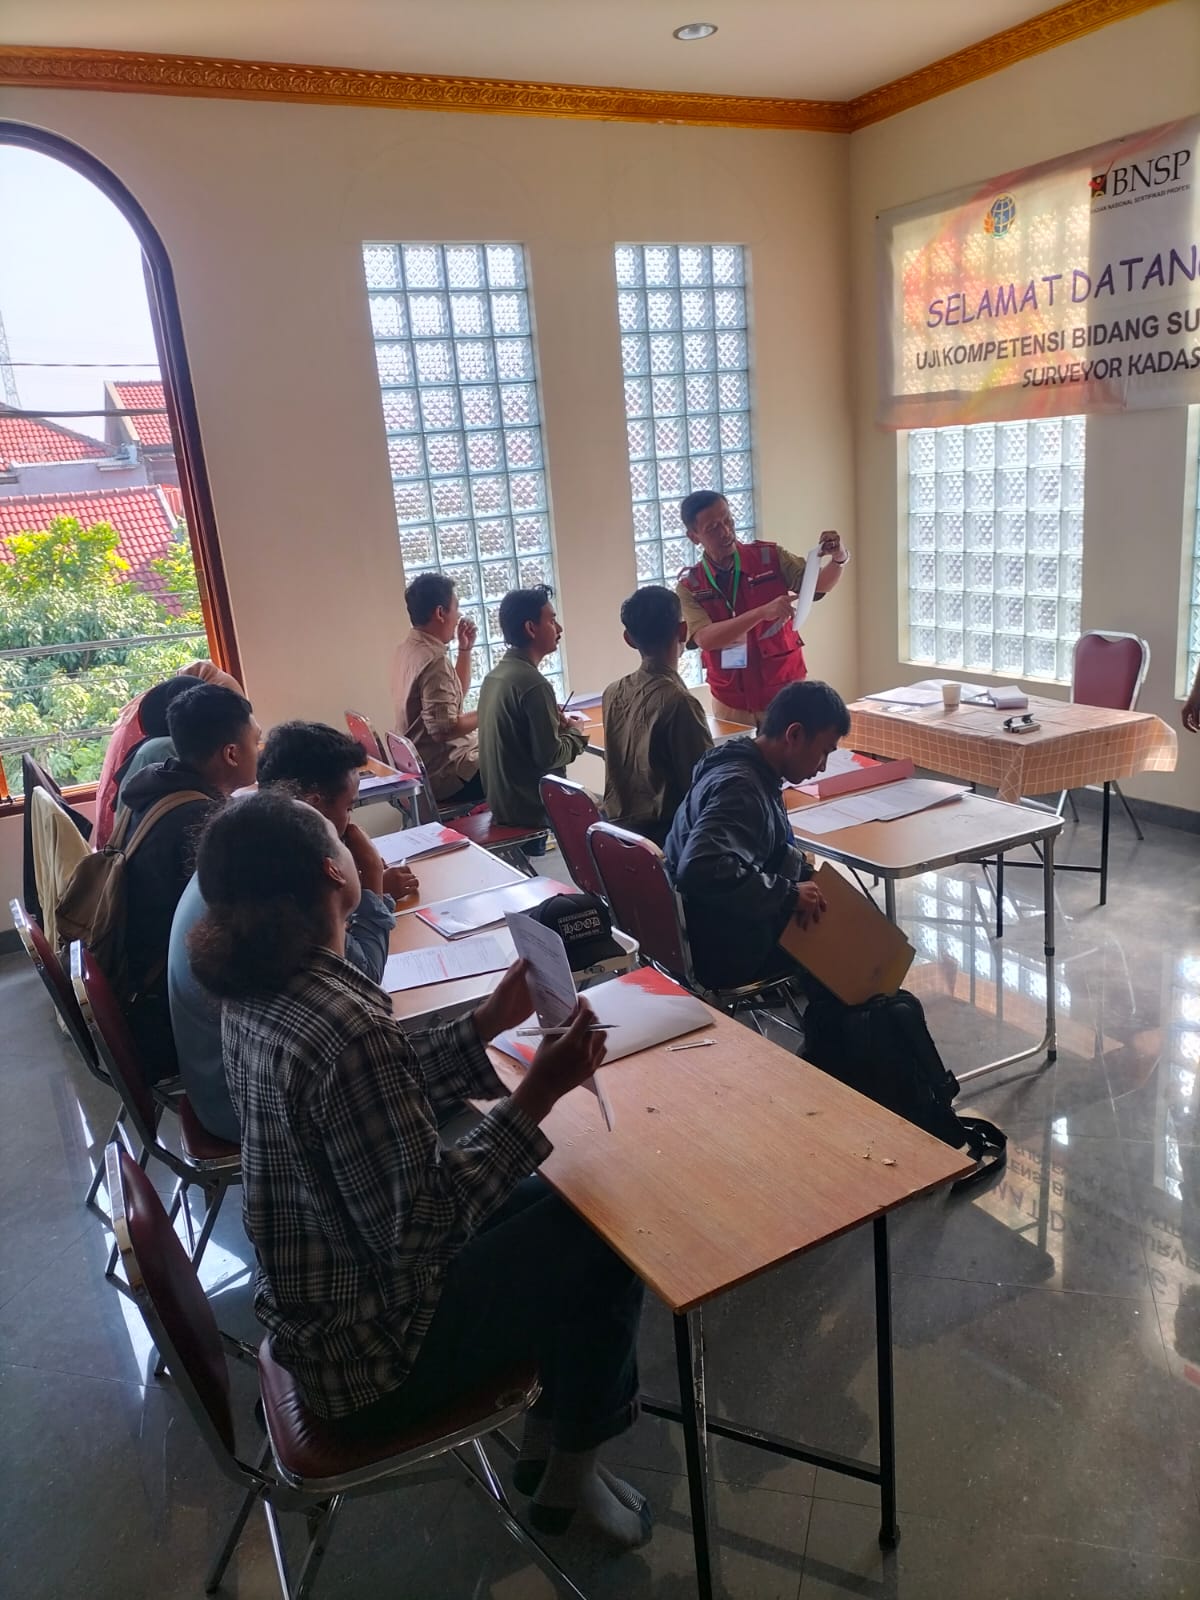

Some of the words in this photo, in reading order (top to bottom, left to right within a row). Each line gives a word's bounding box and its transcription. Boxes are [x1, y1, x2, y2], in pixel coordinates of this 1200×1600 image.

[1112, 149, 1191, 197] BNSP
[927, 274, 1063, 328] SELAMAT
[1071, 244, 1200, 303] DATAN
[943, 330, 1065, 367] KOMPETENSI
[1072, 315, 1160, 348] BIDANG
[1167, 308, 1200, 335] SU
[1022, 357, 1122, 388] SURVEYOR
